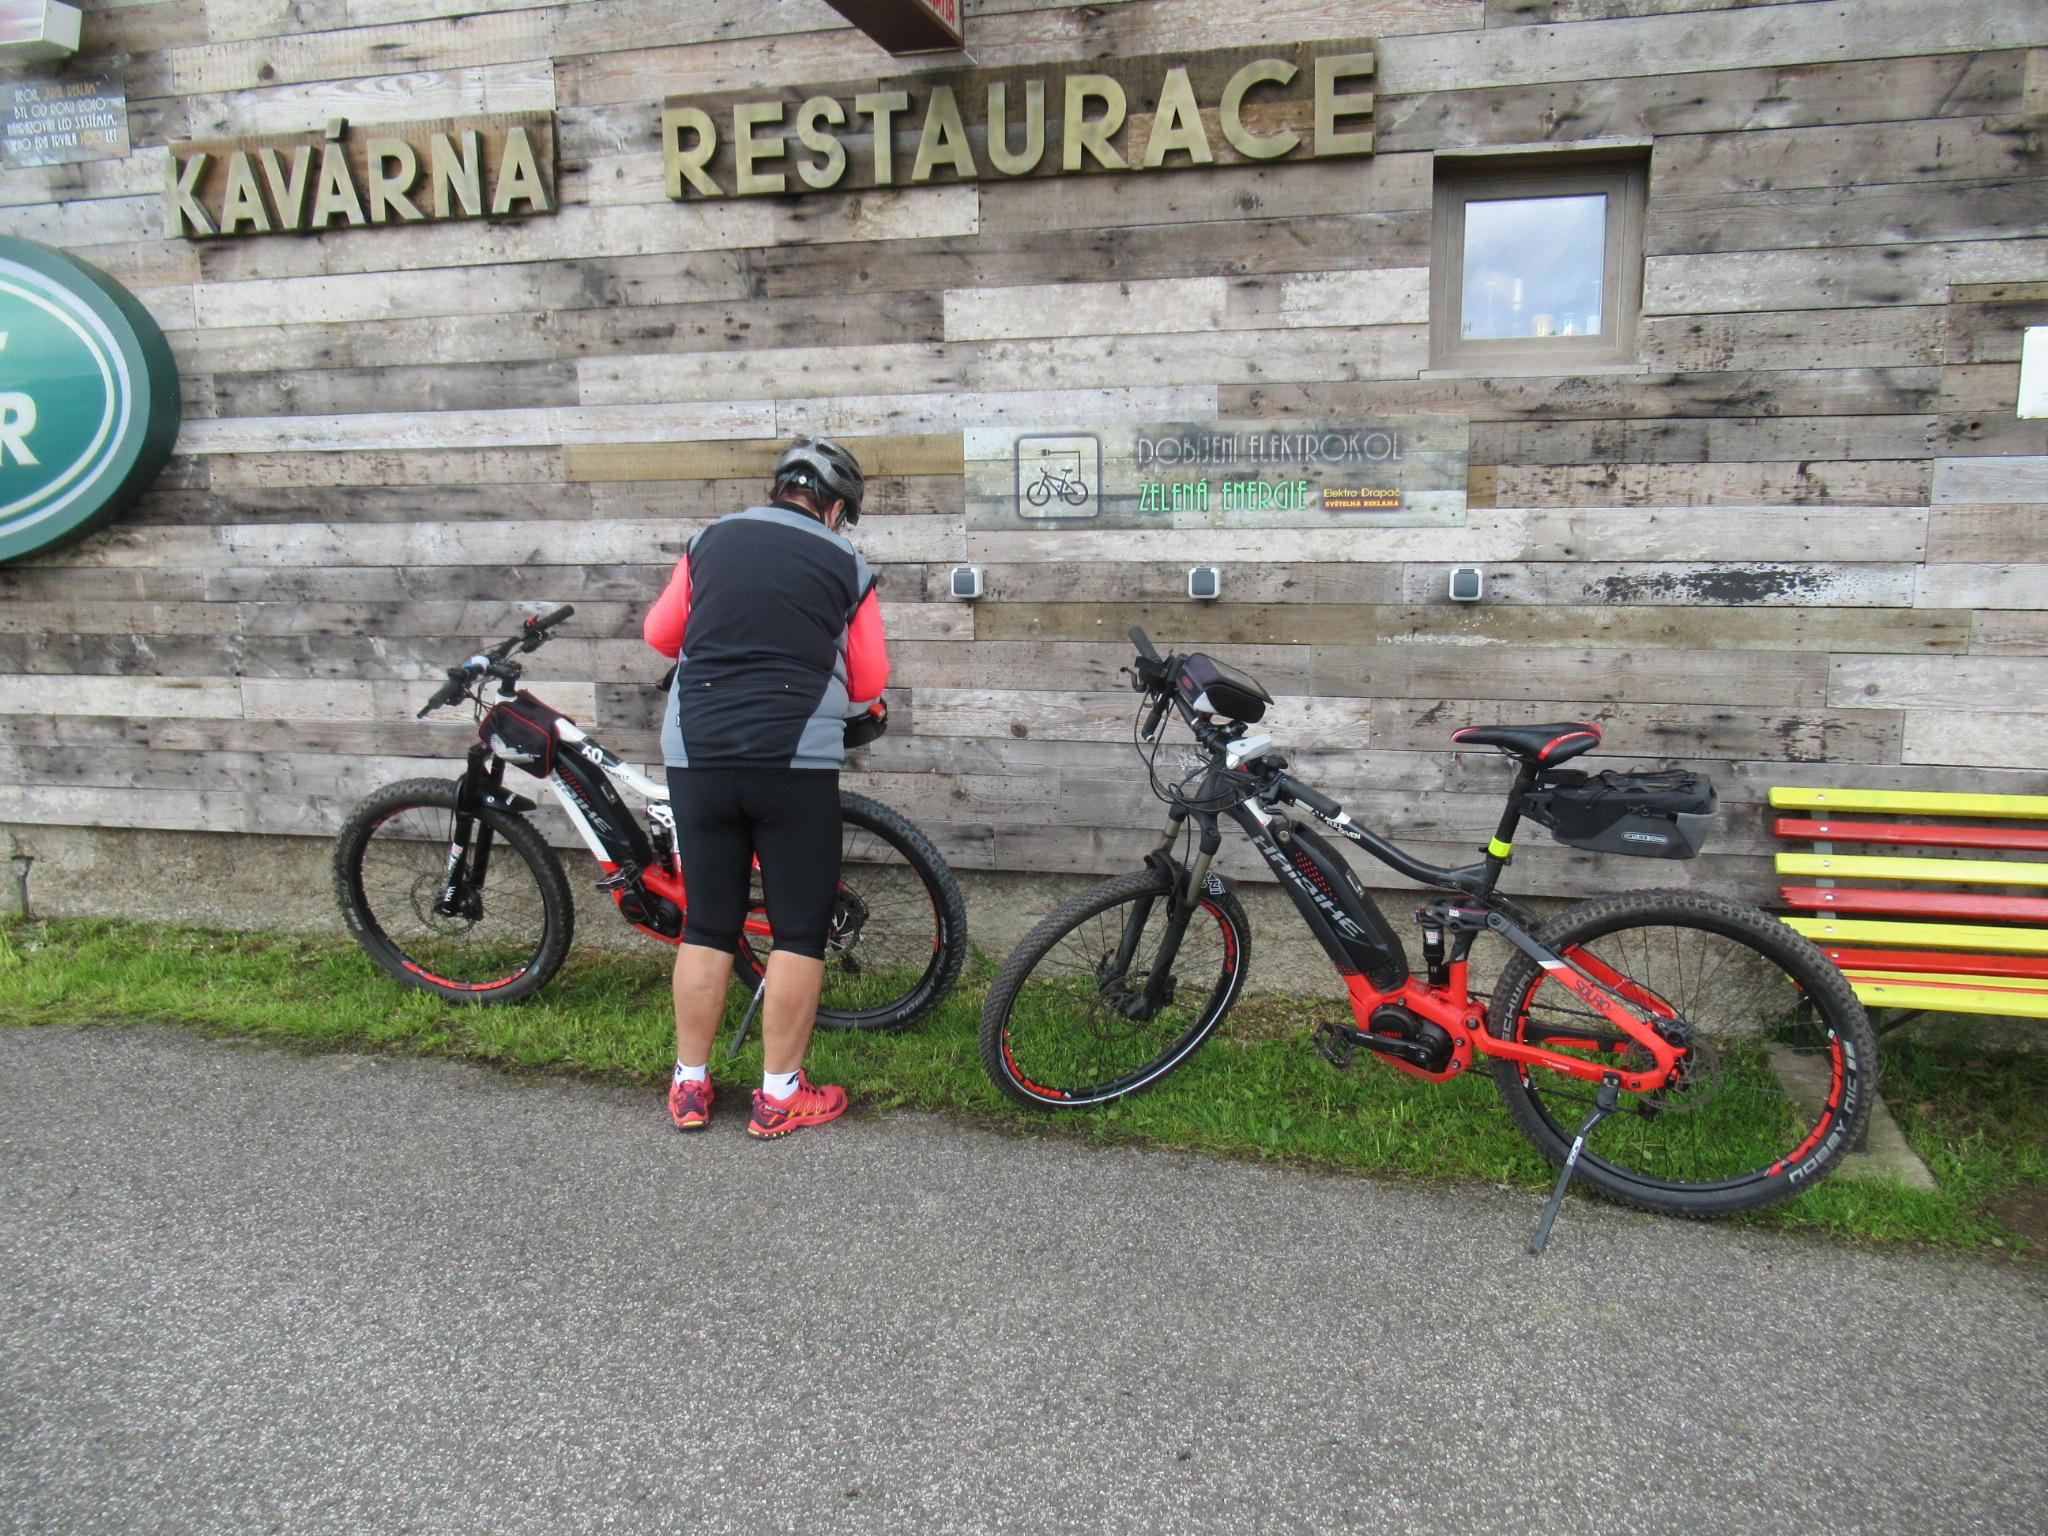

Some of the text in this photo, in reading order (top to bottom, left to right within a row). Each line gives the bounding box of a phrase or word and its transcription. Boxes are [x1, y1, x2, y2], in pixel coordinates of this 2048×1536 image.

[31, 104, 47, 117] OD
[77, 97, 106, 113] 2010
[58, 117, 72, 131] LED
[664, 52, 1375, 200] RESTAURACE
[165, 117, 552, 236] KAVÁRNA
[1249, 432, 1402, 463] ELEKTROKOL
[1138, 478, 1307, 512] ZELENÁ ENERGIE
[1323, 488, 1358, 498] Elektro
[1502, 966, 1540, 1043] SCHWAL
